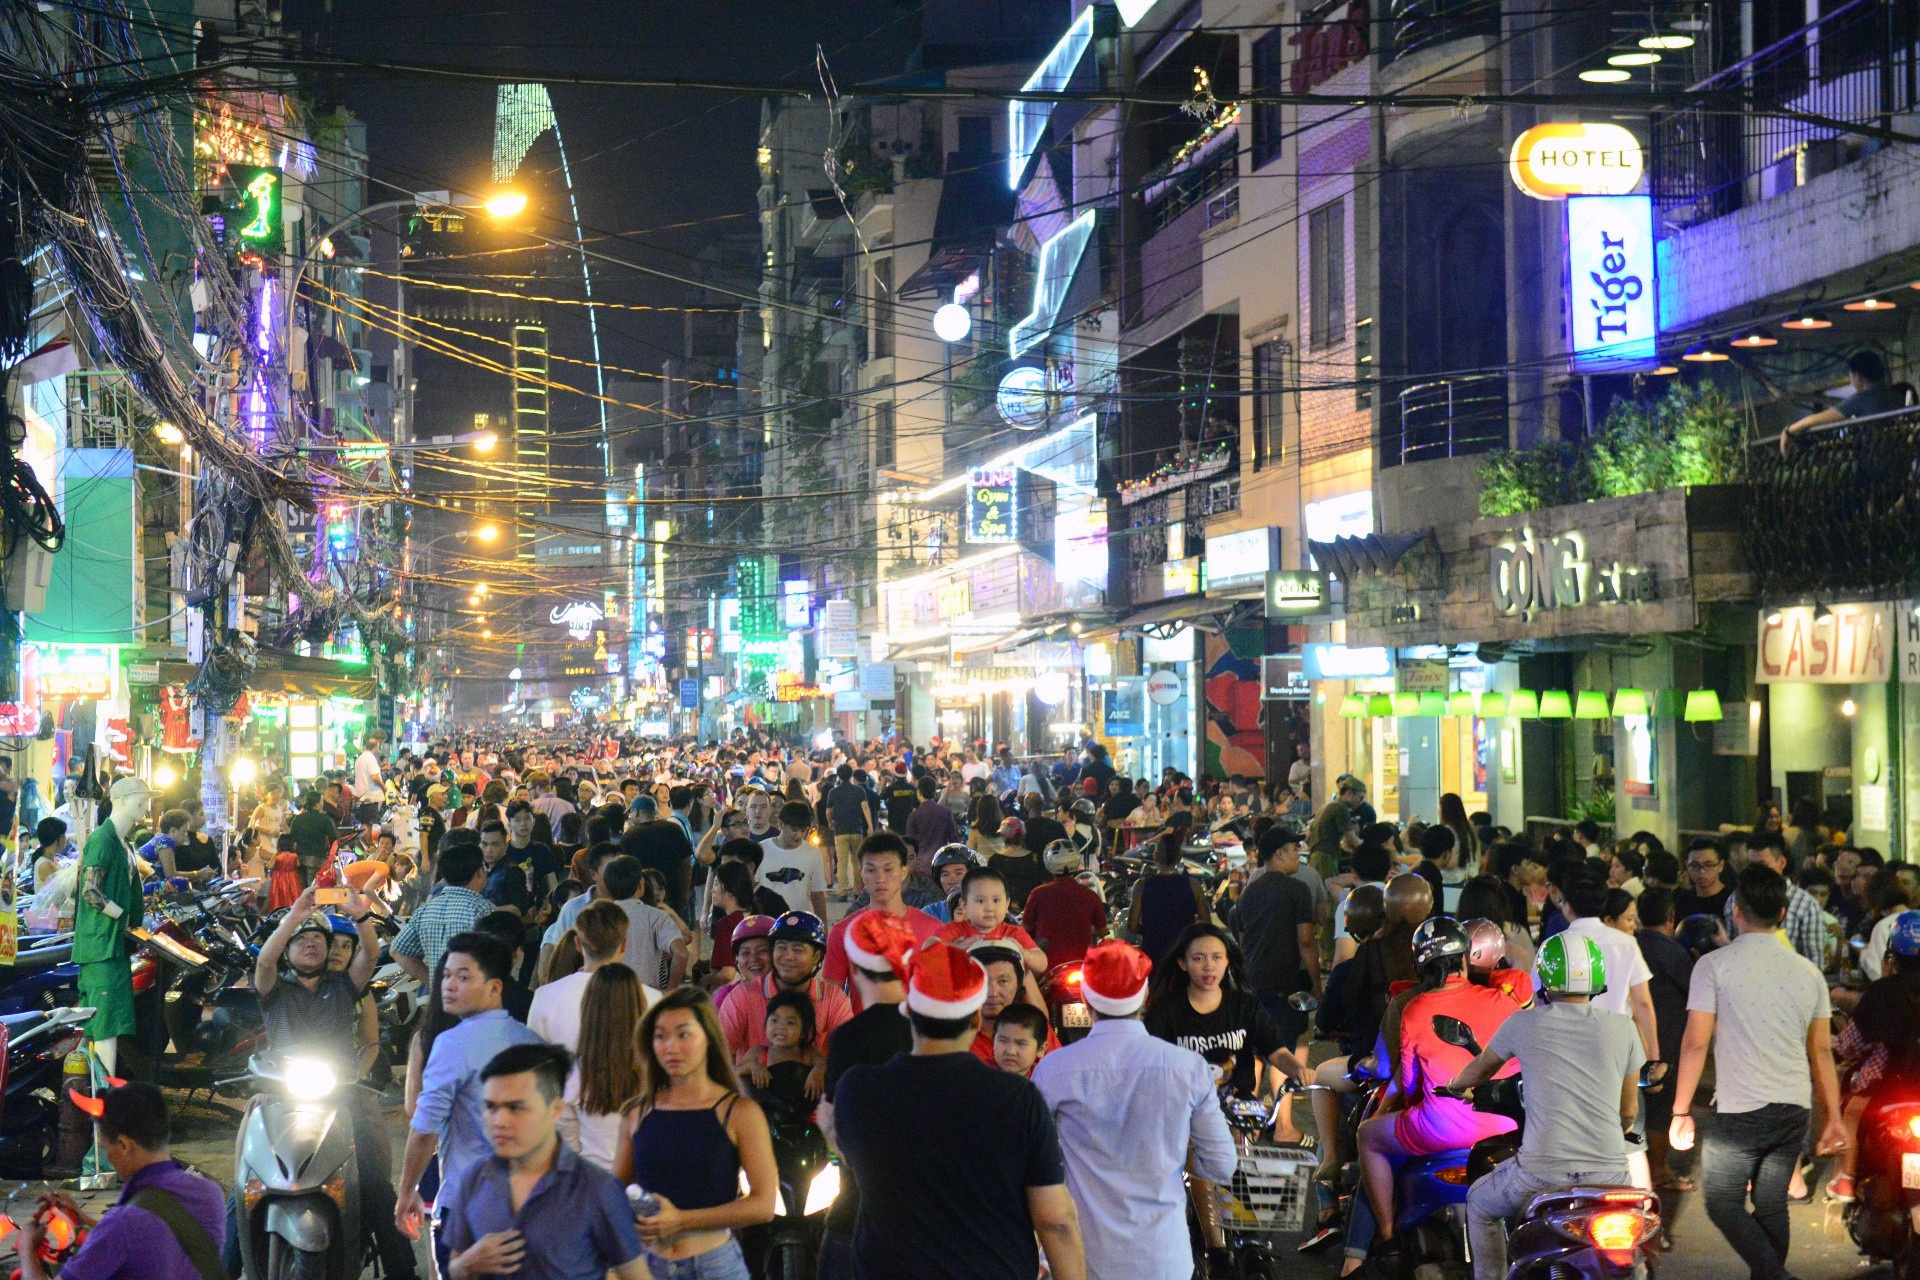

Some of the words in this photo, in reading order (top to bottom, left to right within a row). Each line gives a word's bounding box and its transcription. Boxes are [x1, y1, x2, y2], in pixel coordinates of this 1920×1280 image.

[1541, 149, 1632, 168] HOTEL
[1590, 230, 1643, 342] Tiger
[977, 488, 1009, 506] Gym
[1761, 612, 1885, 676] CASITA
[1109, 710, 1131, 720] ANZ
